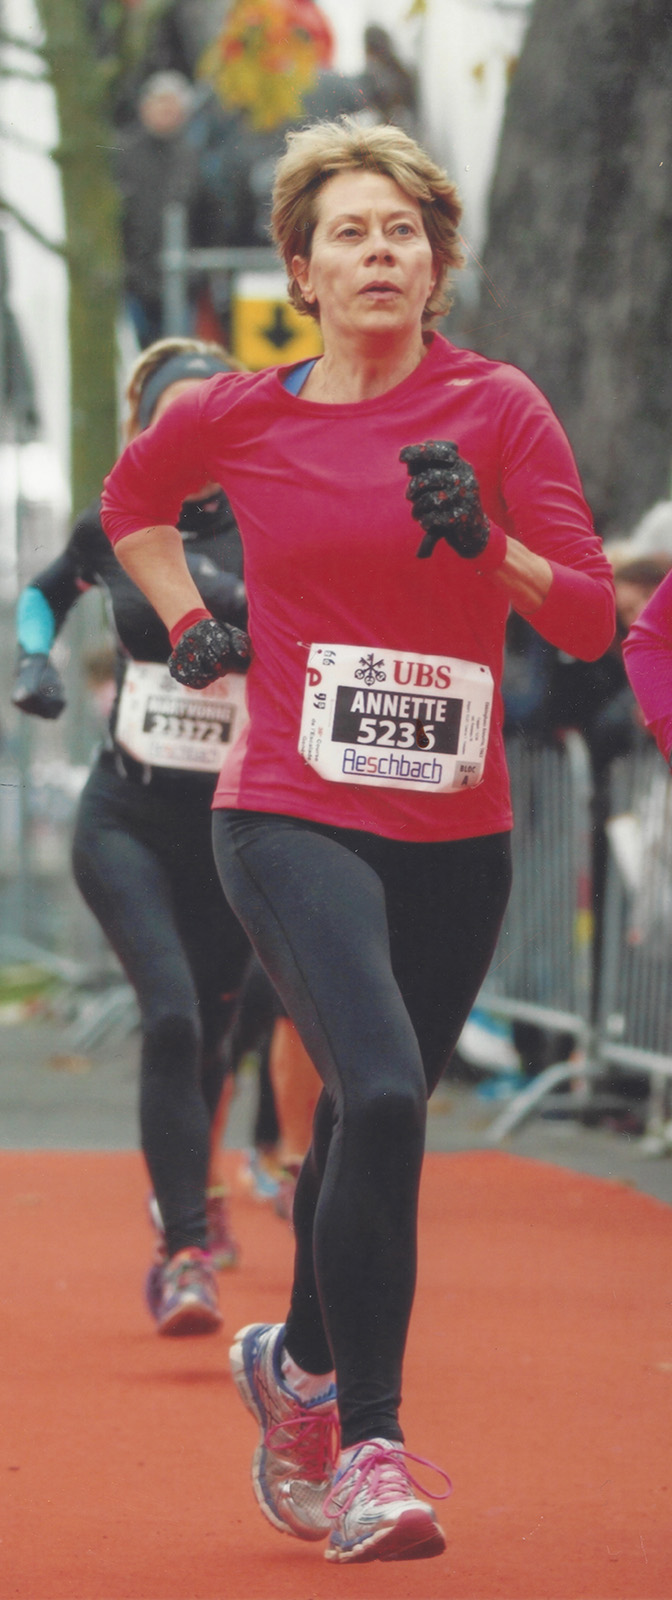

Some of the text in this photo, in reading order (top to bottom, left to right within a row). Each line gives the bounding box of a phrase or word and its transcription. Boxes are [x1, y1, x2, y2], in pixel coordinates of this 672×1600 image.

[393, 660, 451, 690] UBS
[350, 690, 447, 722] ANNETTE
[151, 714, 223, 743] 23372
[342, 748, 442, 784] Aeschbach
[460, 765, 476, 773] BLOC
[461, 775, 469, 786] A
